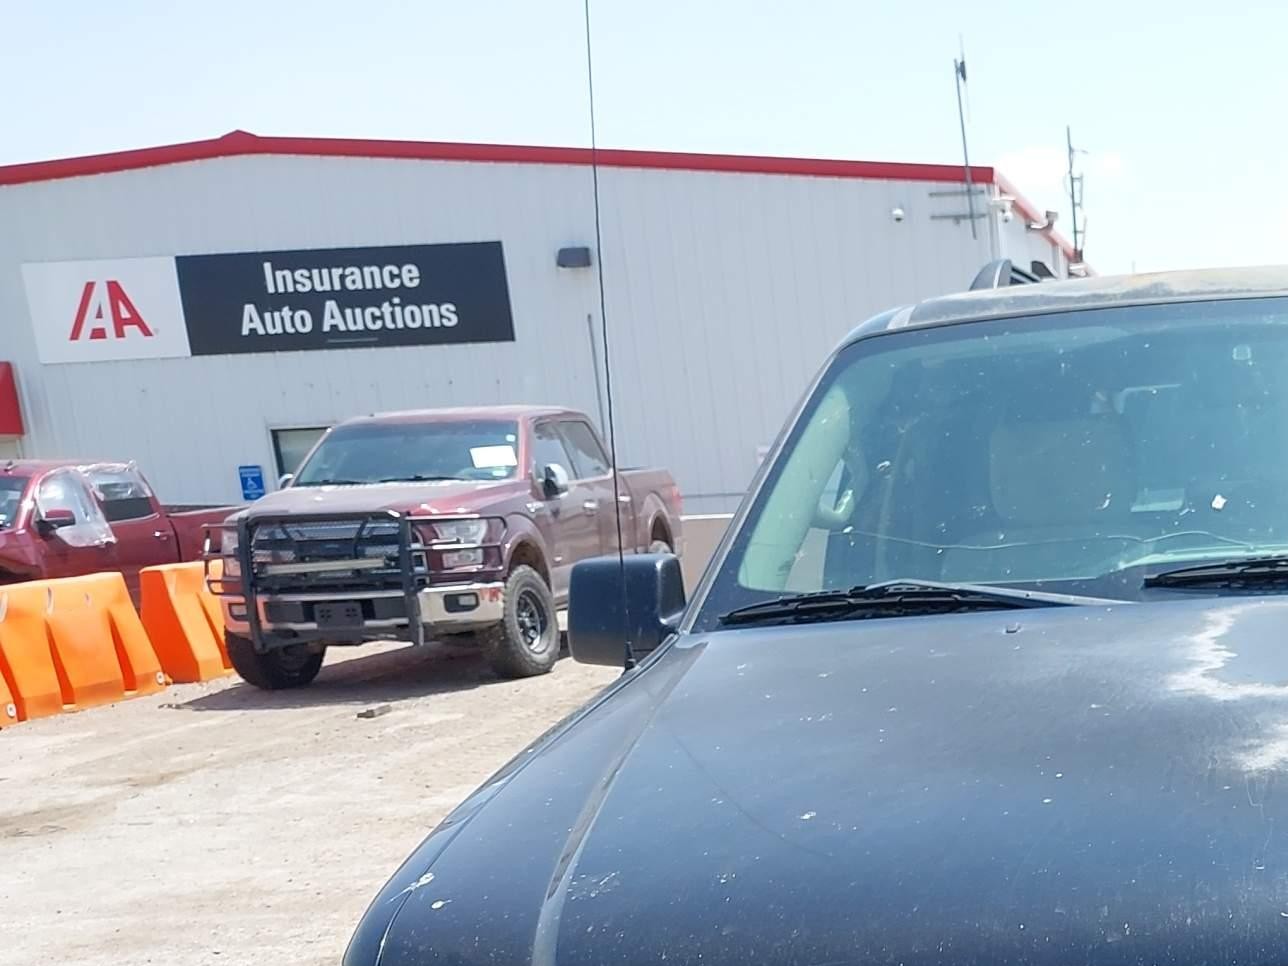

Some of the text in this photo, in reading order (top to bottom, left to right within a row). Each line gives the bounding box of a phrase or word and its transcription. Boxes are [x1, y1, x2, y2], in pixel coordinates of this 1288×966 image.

[263, 261, 420, 294] Insurance
[241, 297, 459, 336] Auto Auctions
